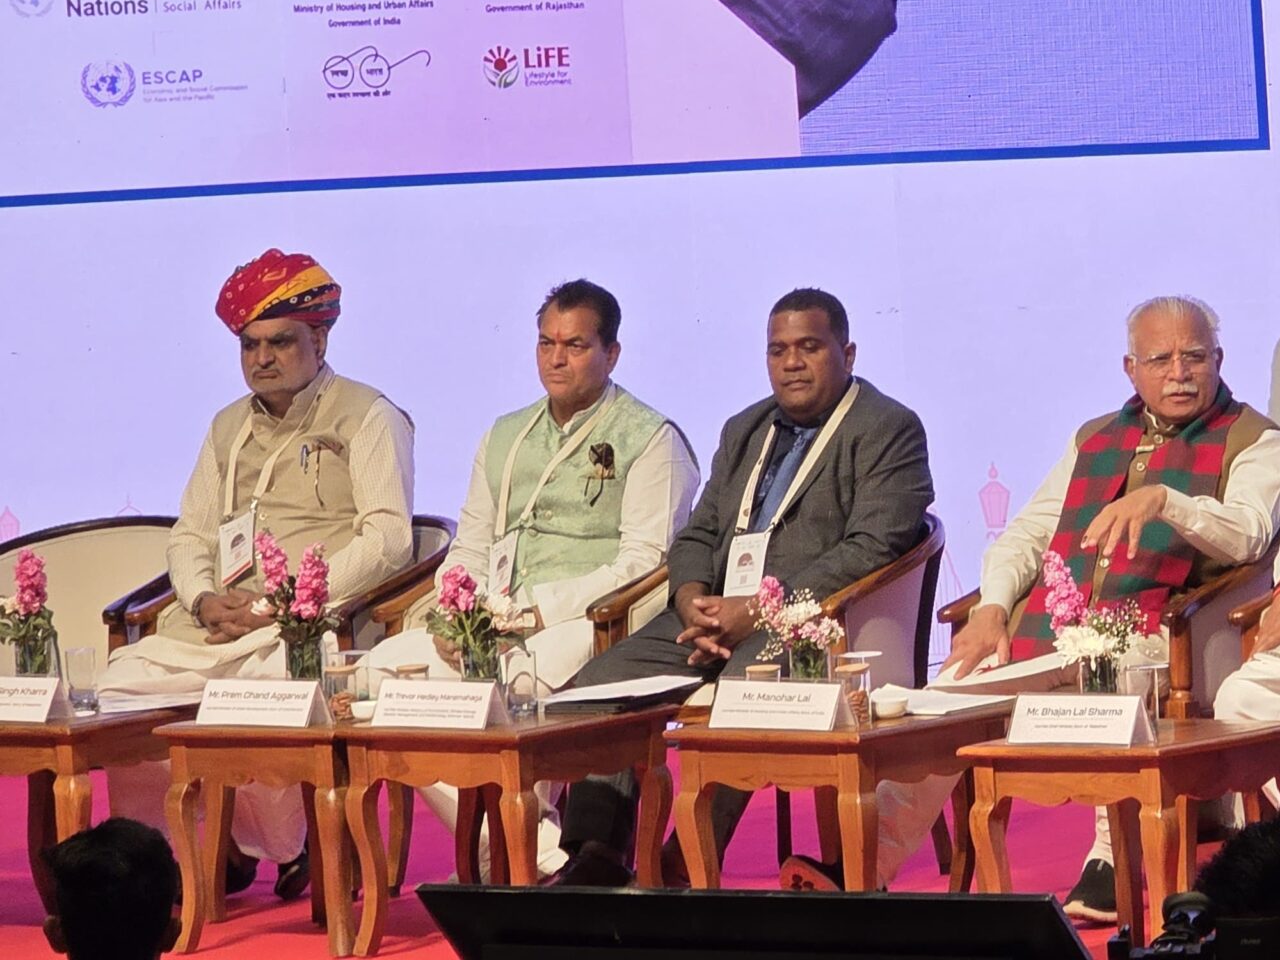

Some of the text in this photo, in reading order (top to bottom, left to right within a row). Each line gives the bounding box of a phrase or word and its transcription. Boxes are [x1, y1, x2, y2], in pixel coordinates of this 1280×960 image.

[163, 0, 241, 12] Social Affairs
[294, 3, 323, 14] Ministry
[326, 2, 334, 12] of
[336, 2, 366, 13] Housing
[368, 1, 382, 10] and
[383, 0, 406, 9] Urban
[485, 1, 585, 13] Government of Rajasthan
[328, 17, 401, 27] Government of India
[523, 46, 570, 69] LiFE
[142, 70, 203, 84] ESCAP
[757, 693, 796, 701] Manohar
[797, 694, 811, 702] Lal
[1027, 707, 1123, 718] Mr. Bhajan Lal Sharma
